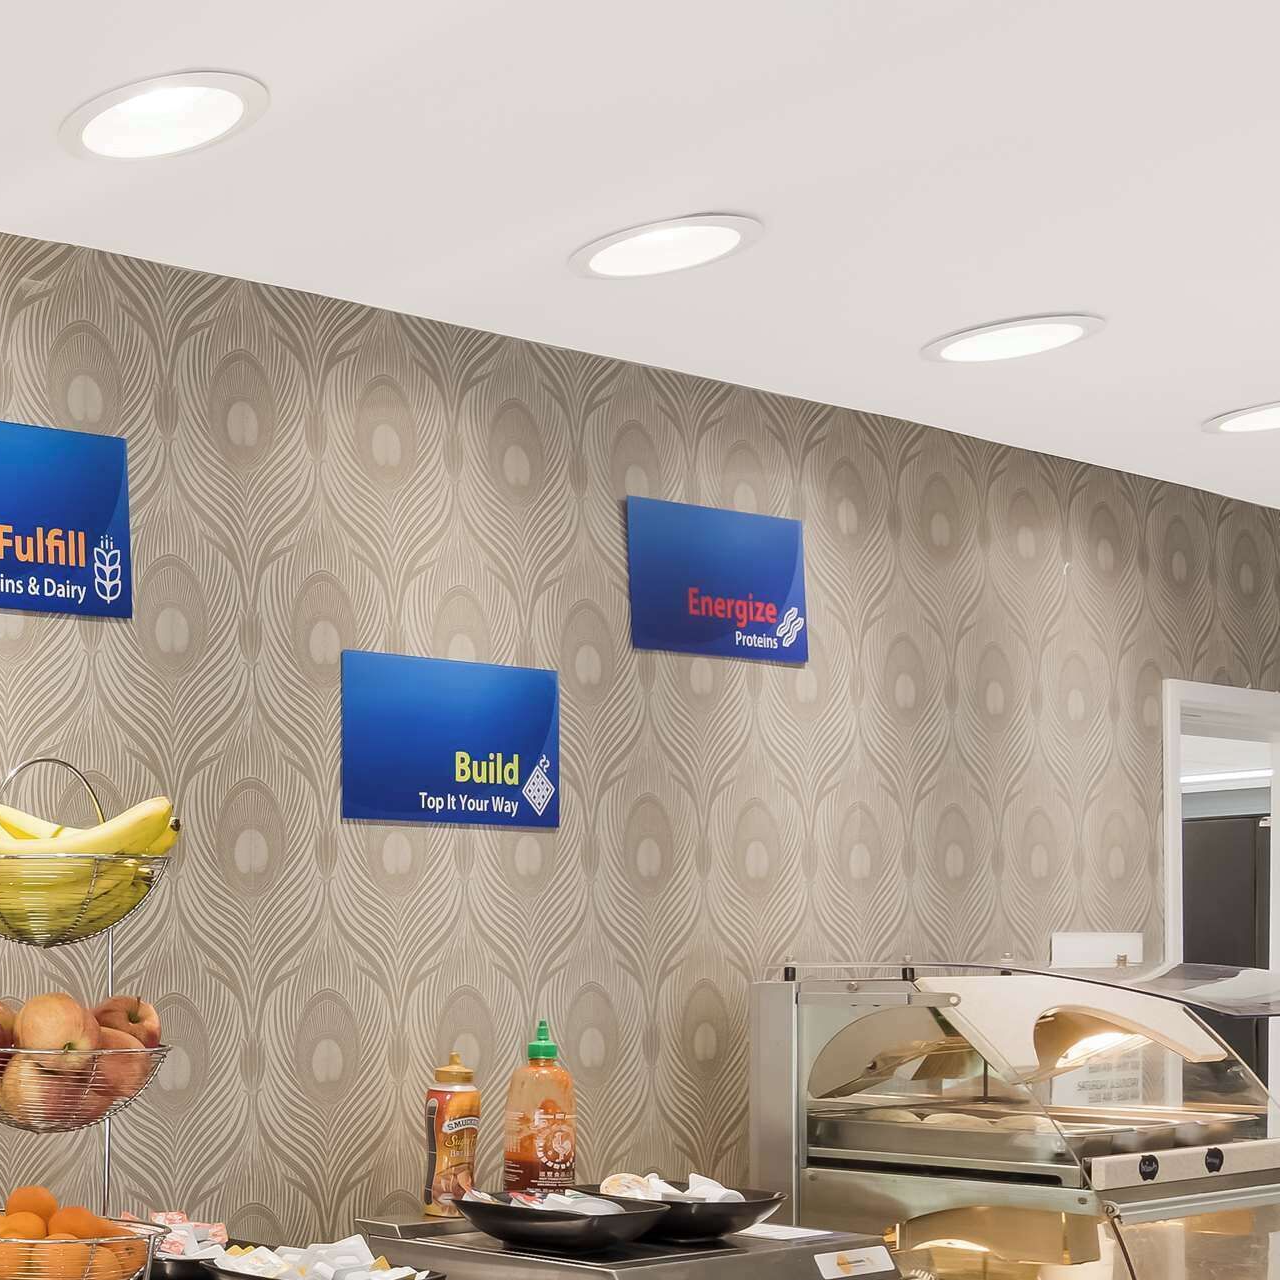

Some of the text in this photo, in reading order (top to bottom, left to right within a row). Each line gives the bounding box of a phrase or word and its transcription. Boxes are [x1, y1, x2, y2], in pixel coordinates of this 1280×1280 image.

[27, 576, 40, 596] &
[43, 577, 87, 605] Dairy
[688, 586, 778, 628] Energize
[735, 630, 778, 649] Proteins
[455, 751, 520, 786] Build
[418, 792, 519, 818] Top It Your Way
